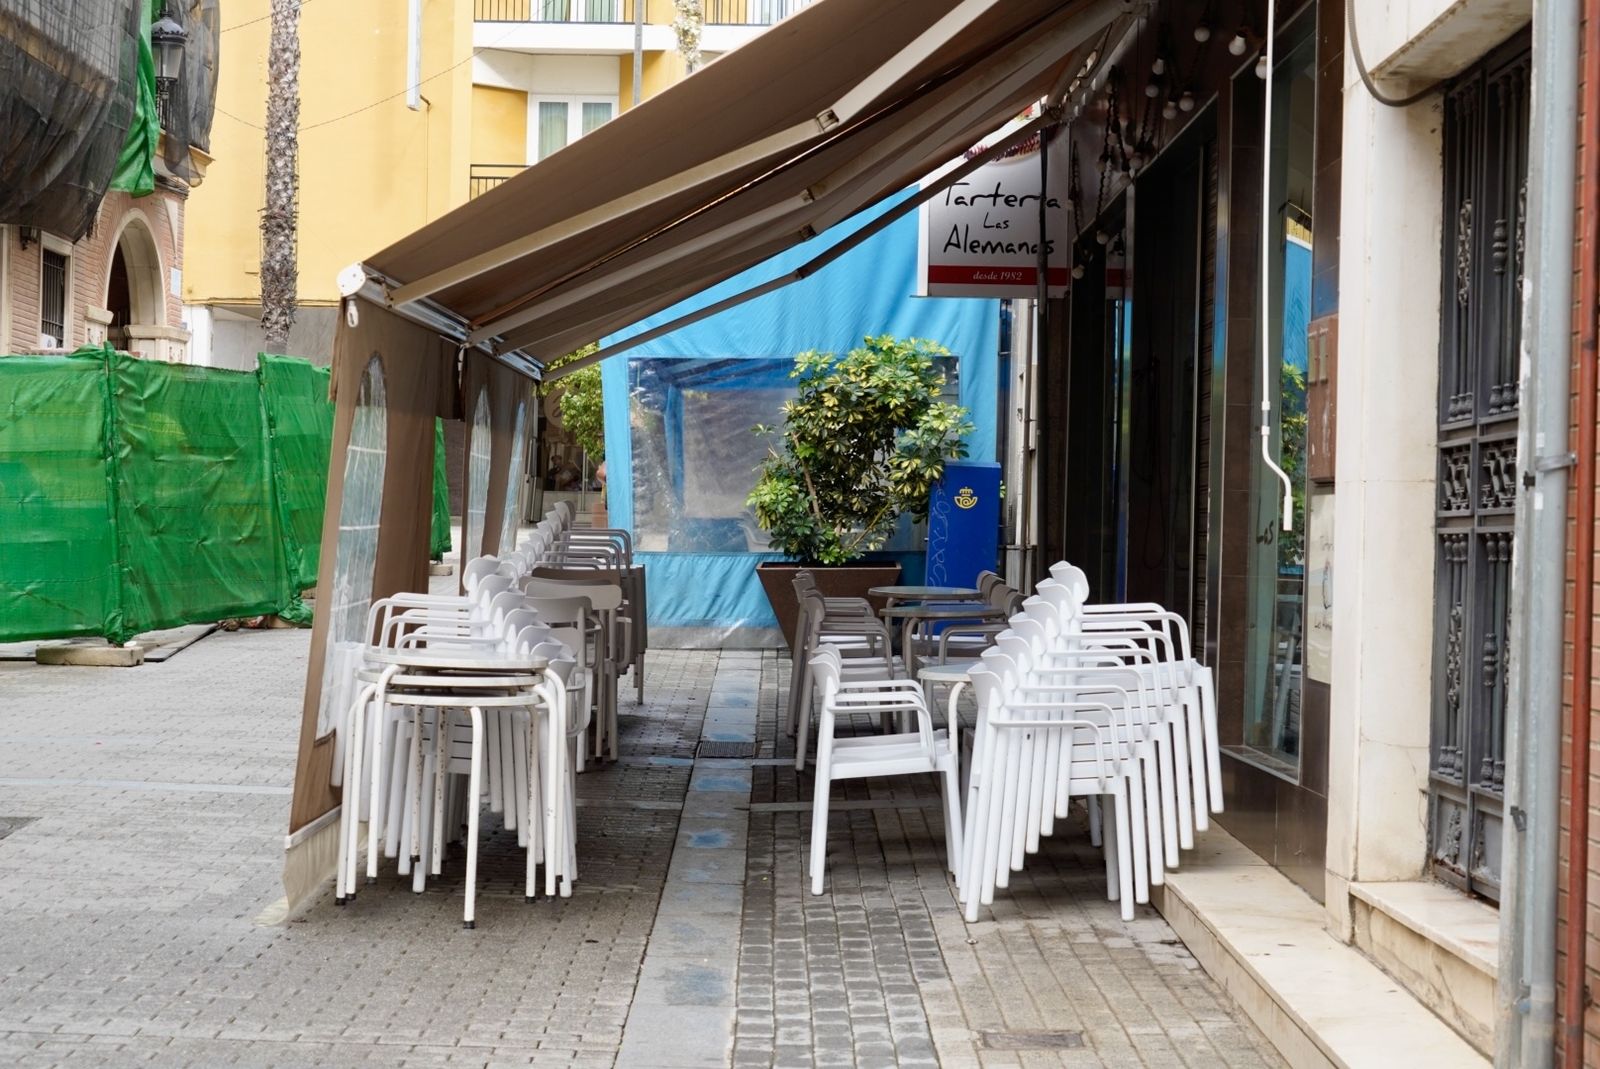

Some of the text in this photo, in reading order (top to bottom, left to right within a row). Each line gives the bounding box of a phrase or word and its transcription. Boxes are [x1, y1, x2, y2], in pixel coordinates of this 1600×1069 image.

[945, 182, 1061, 209] Tartera
[983, 212, 1009, 230] Las
[973, 270, 1023, 281] desde 1982
